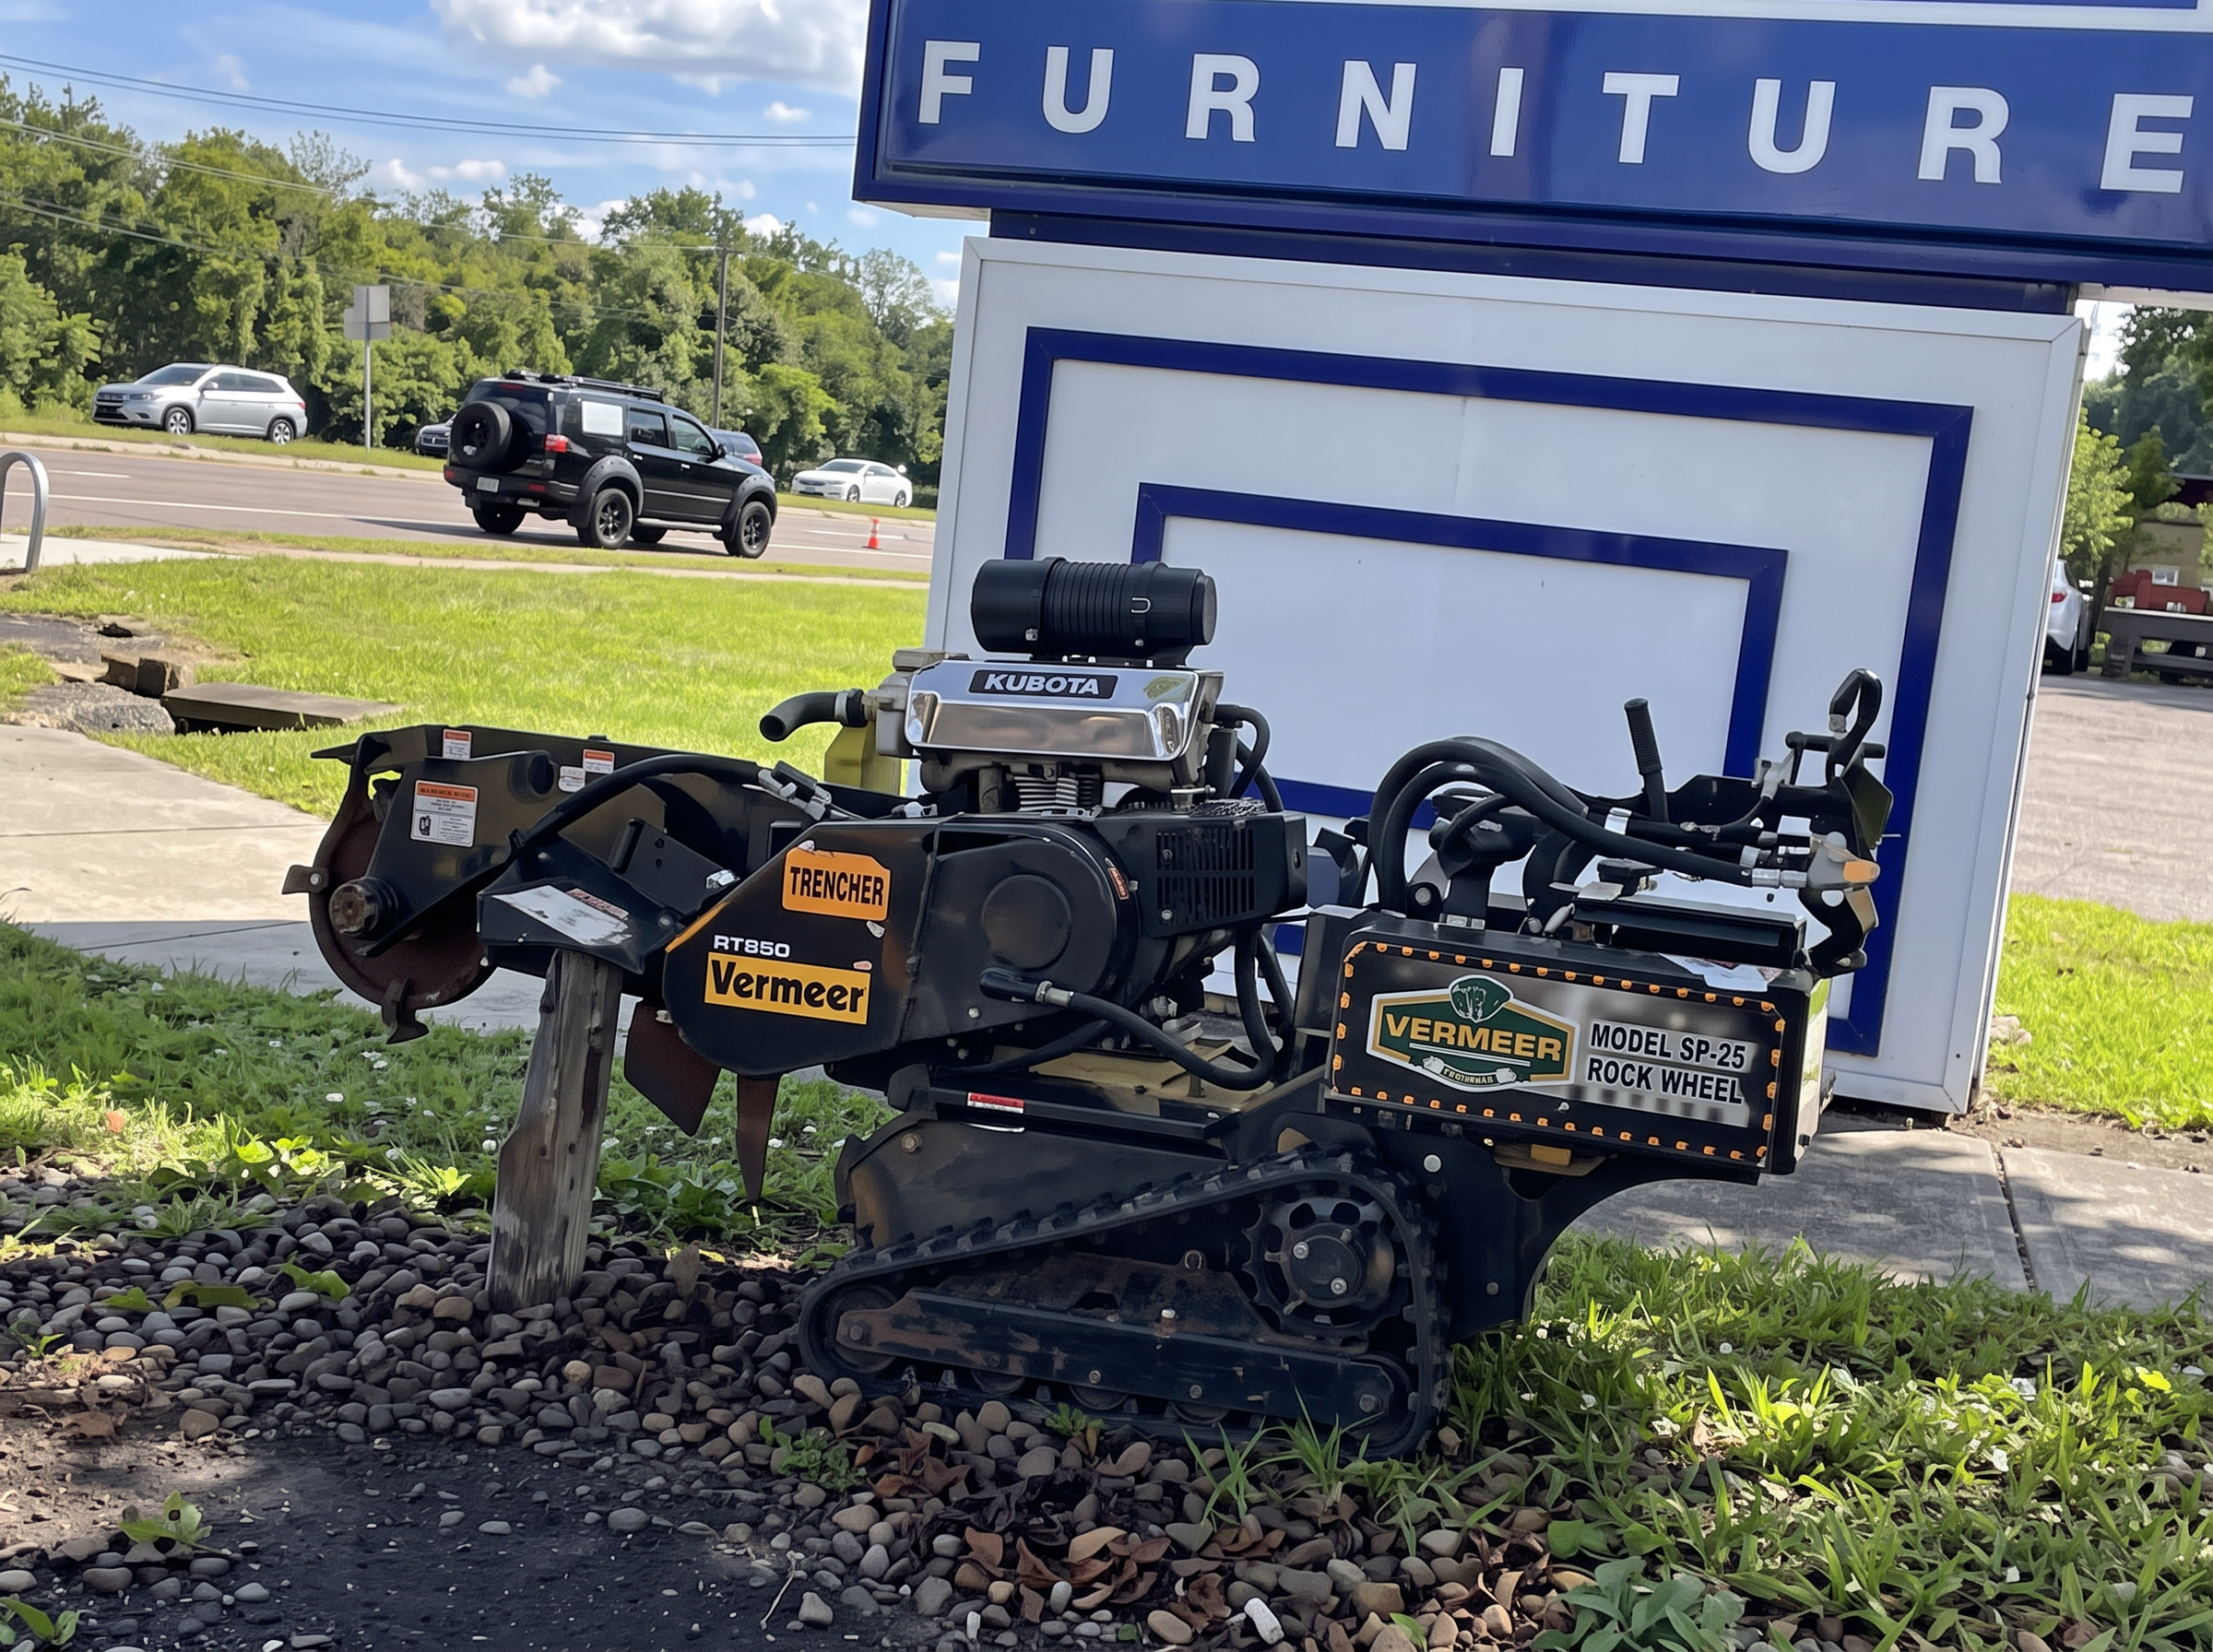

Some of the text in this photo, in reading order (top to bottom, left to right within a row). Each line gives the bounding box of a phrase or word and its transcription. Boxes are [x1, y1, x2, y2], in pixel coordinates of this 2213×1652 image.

[917, 40, 2195, 194] FURNITURE
[984, 673, 1099, 695] KUBOTA
[789, 866, 884, 906] TRENCHER
[713, 934, 790, 958] RT850
[710, 959, 866, 1013] Vermeer
[1385, 1013, 1563, 1062] VERMEER
[1590, 1022, 1746, 1069] MODEL SP-25
[1587, 1056, 1743, 1104] ROCK WHEEL
